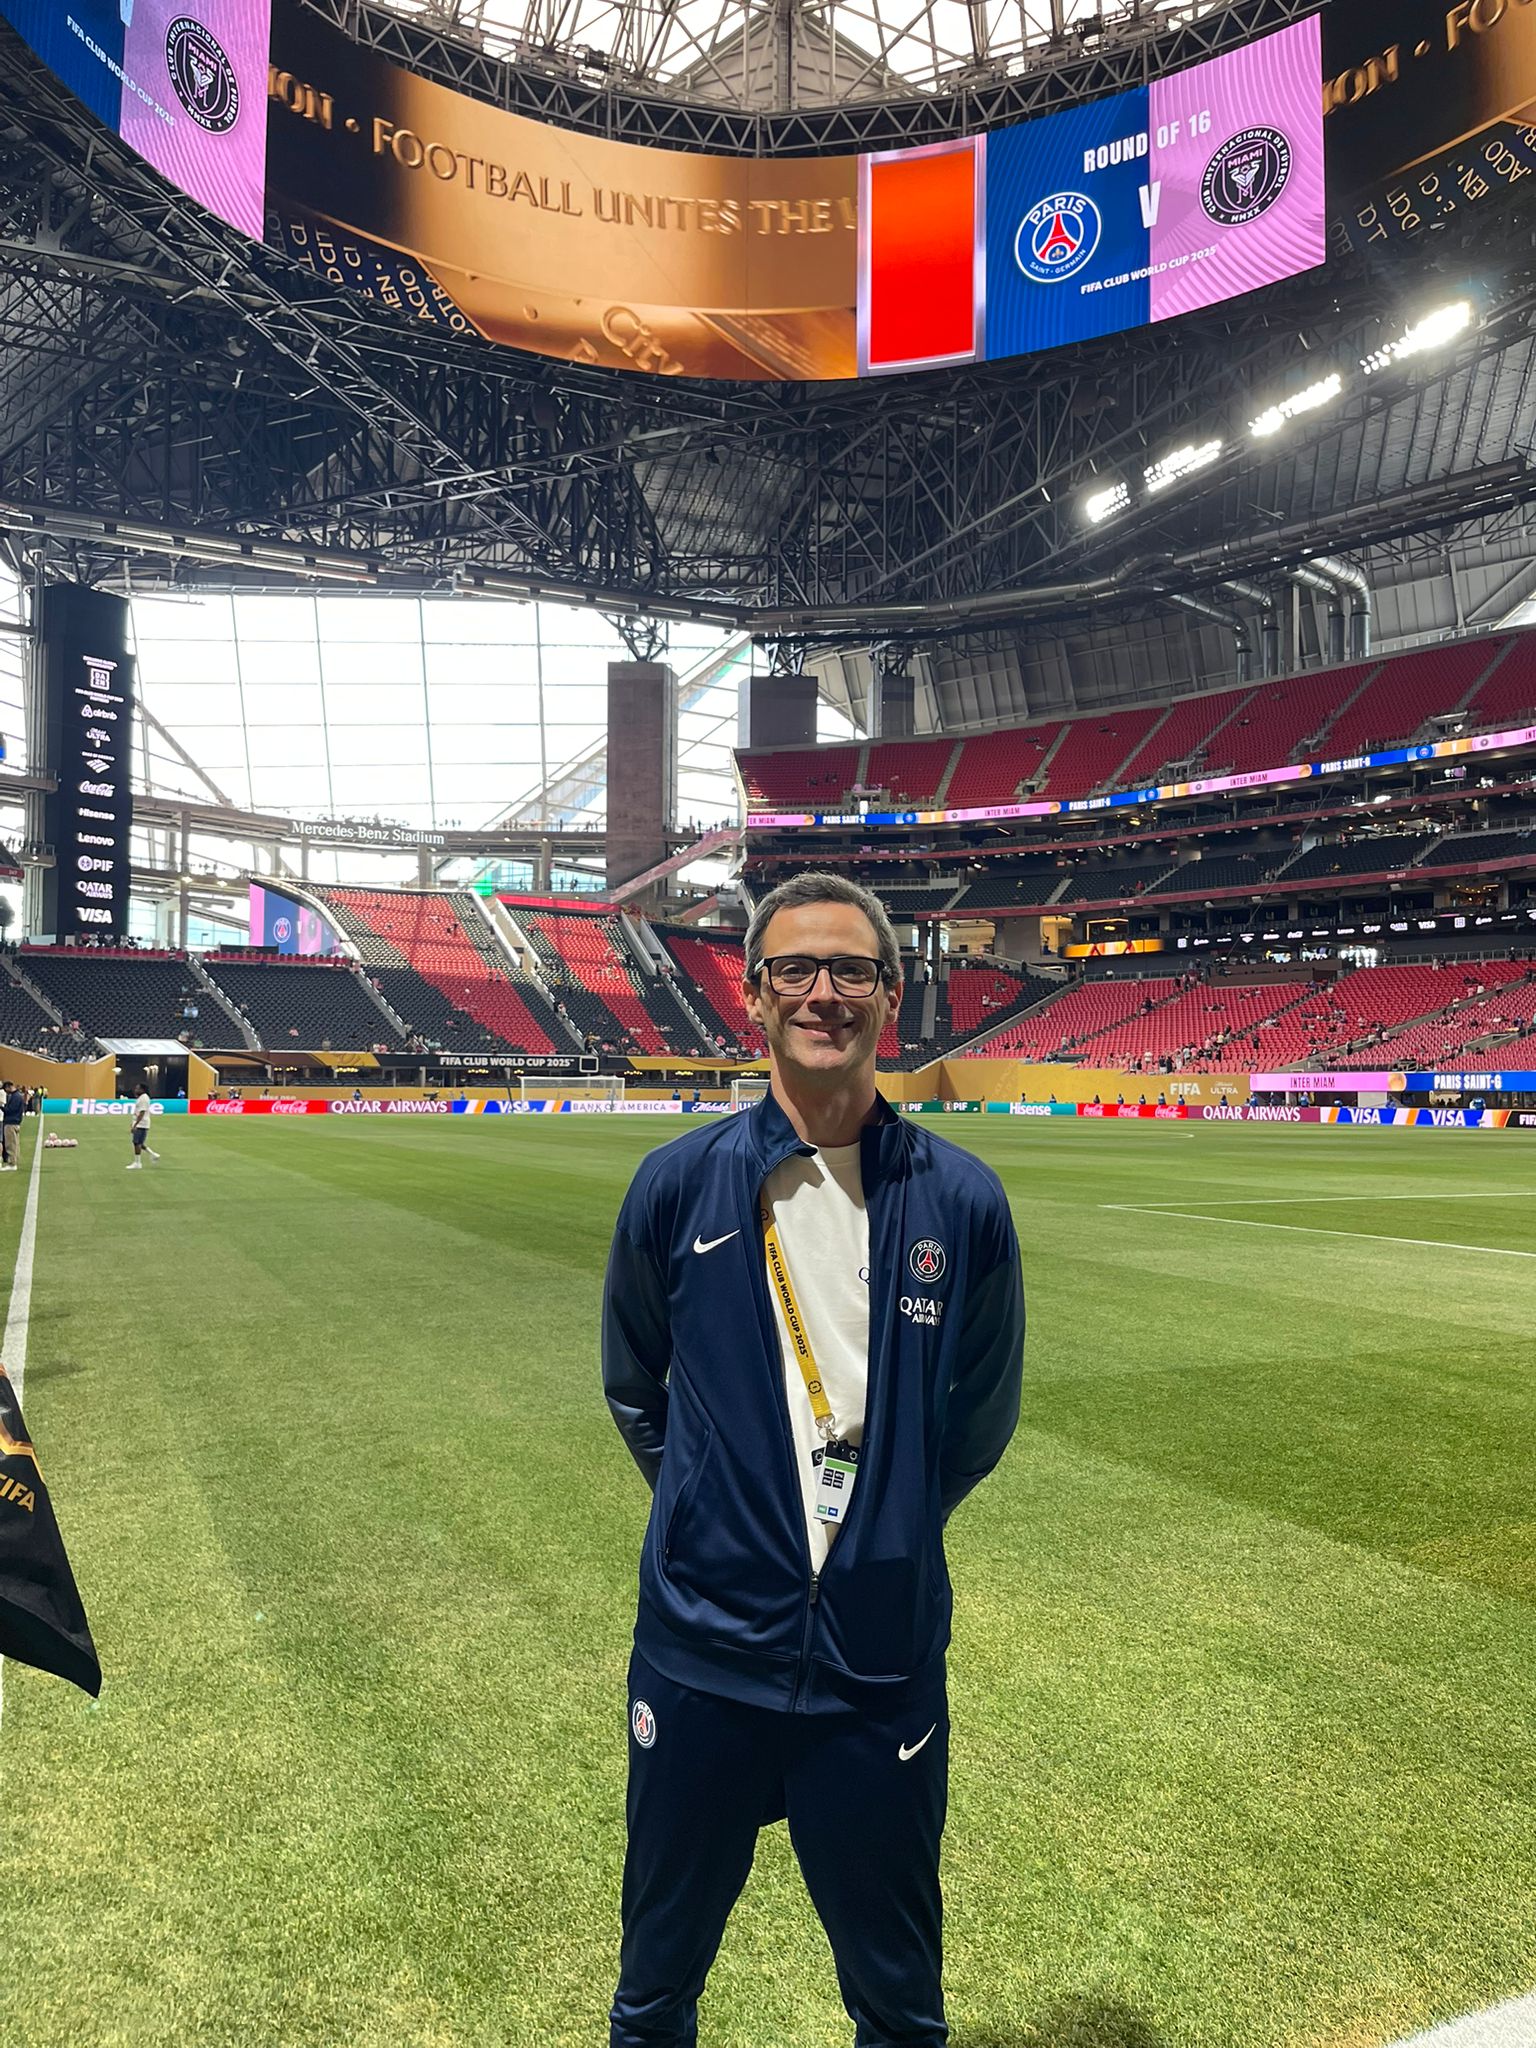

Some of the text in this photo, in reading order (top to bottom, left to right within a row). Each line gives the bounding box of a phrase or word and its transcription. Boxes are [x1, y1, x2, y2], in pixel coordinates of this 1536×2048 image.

[188, 41, 217, 71] MIAMI
[66, 15, 176, 127] FIFA CLUB WORLD CUP 2025
[1083, 110, 1212, 174] ROUND OF 16
[1273, 136, 1284, 149] DE
[1203, 130, 1273, 186] INTERNACIONAL
[1227, 148, 1263, 169] MIAMI
[372, 117, 583, 217] FOOTBALL
[592, 186, 743, 236] UNITES
[748, 198, 835, 236] THE
[1138, 180, 1161, 229] V
[1203, 190, 1216, 213] CLUB
[1029, 196, 1087, 225] PARIS
[1080, 245, 1217, 295] FIFA CLUB WORLD CUP 2025
[93, 709, 117, 720] airbnb
[78, 808, 115, 821] Hisense
[78, 832, 115, 846] Lenovo
[291, 821, 445, 846] Mercedes-Benz Stadium
[93, 859, 114, 872] PIF
[77, 881, 113, 894] QATAR
[77, 907, 113, 924] VISA
[440, 1056, 462, 1067] FIFA
[463, 1056, 489, 1067] CLUB
[490, 1057, 525, 1067] WORLD
[526, 1058, 545, 1067] CUP
[1170, 1082, 1200, 1095] FIFA
[1290, 1076, 1335, 1088] INTER MIAM
[1434, 1074, 1502, 1089] PARIS SAINT-G
[1210, 1087, 1238, 1095] ULTRA
[70, 1099, 164, 1115] Hisene
[331, 1101, 448, 1114] QATAR AIRWAYS
[573, 1103, 601, 1111] BANK
[620, 1103, 667, 1111] AMERICA
[909, 1103, 923, 1112] PIF
[953, 1102, 968, 1111] PIF
[1009, 1100, 1052, 1115] Hisense
[1203, 1105, 1301, 1122] QATAR AIRWAYS
[1349, 1108, 1381, 1124] VISA
[1430, 1109, 1466, 1126] VISA
[768, 1242, 779, 1261] FIFA
[917, 1243, 941, 1255] PARIS
[773, 1261, 785, 1283] CLUB
[780, 1283, 795, 1315] WORLD
[900, 1296, 944, 1317] QATAR
[789, 1315, 800, 1334] CUP
